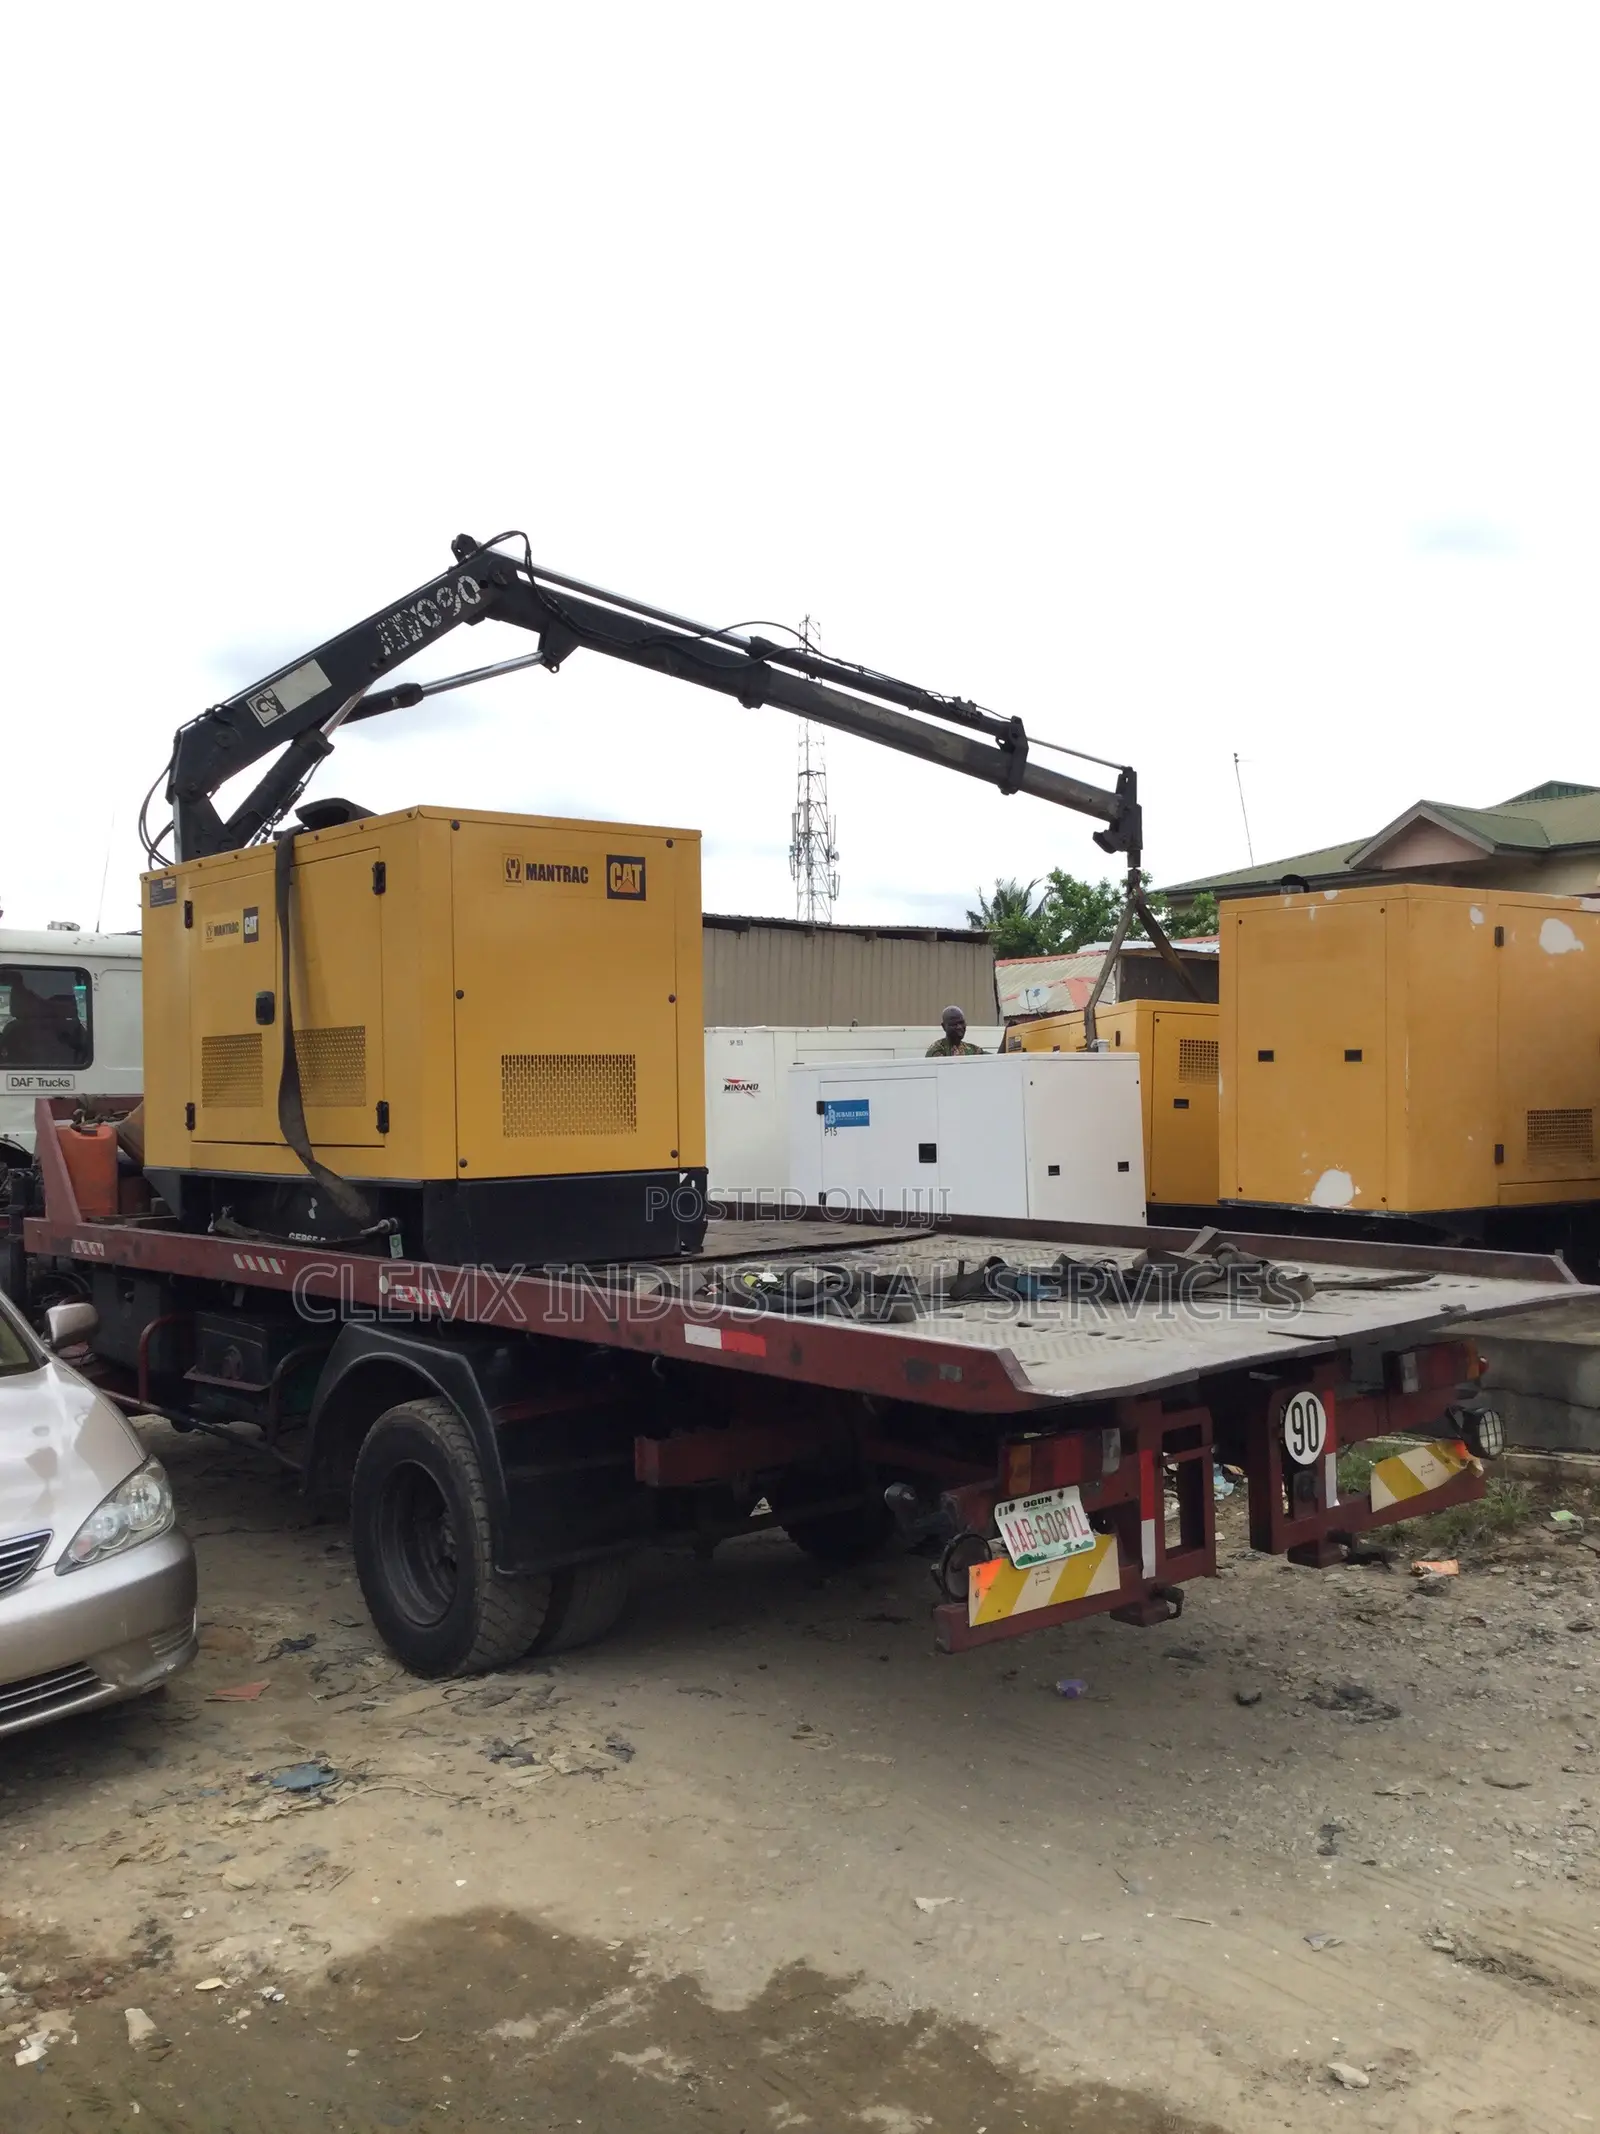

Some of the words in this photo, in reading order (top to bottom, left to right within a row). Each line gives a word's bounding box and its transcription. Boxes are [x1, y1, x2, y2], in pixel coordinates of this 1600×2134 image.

[526, 863, 589, 884] MANTRAC
[609, 862, 643, 894] CAT
[11, 1077, 34, 1088] DAF
[36, 1077, 71, 1088] Trucks
[723, 1083, 759, 1092] MIKANO
[1291, 1398, 1320, 1457] 90
[1023, 1495, 1052, 1509] OGUN
